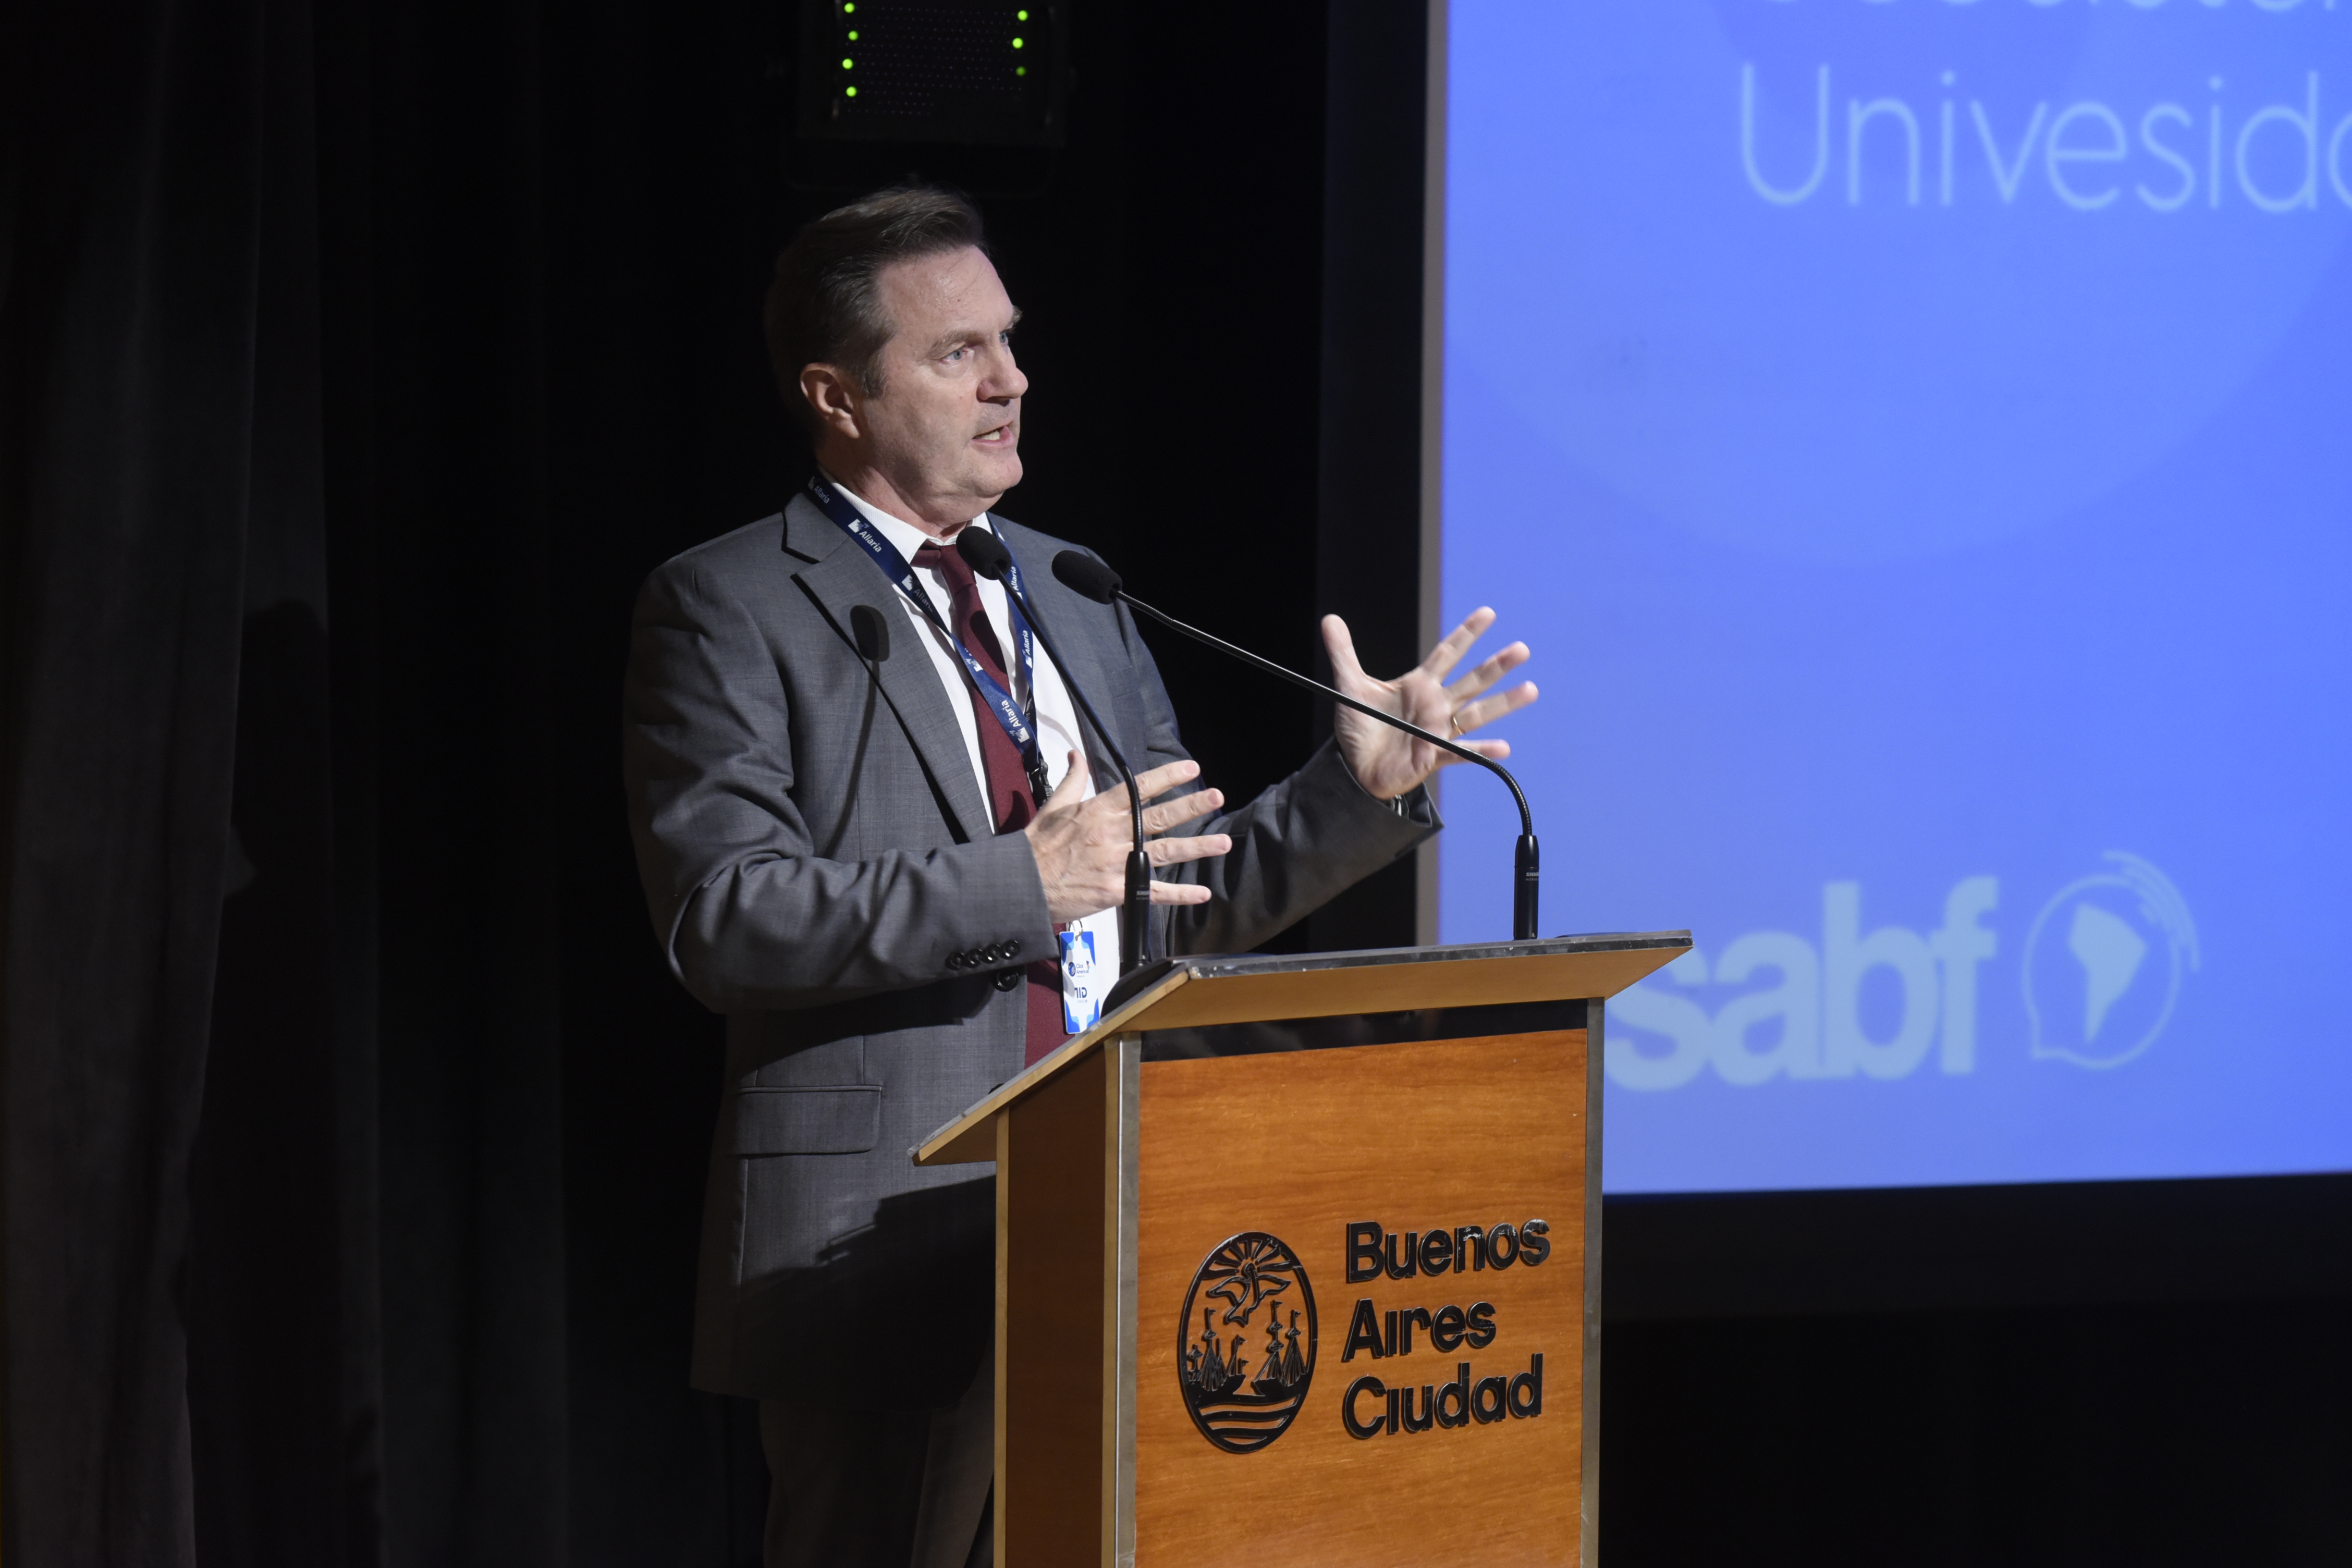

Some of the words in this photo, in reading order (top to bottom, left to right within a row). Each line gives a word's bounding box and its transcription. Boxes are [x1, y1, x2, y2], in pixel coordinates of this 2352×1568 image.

[813, 485, 830, 504] Allaria
[859, 531, 881, 553] Allaria
[1010, 566, 1019, 591] Allaria
[1001, 700, 1021, 728] Allaria
[1606, 875, 1999, 1091] sabf
[1345, 1219, 1551, 1283] Buenos
[1341, 1298, 1497, 1362] Aires
[1342, 1353, 1544, 1439] Ciudad
